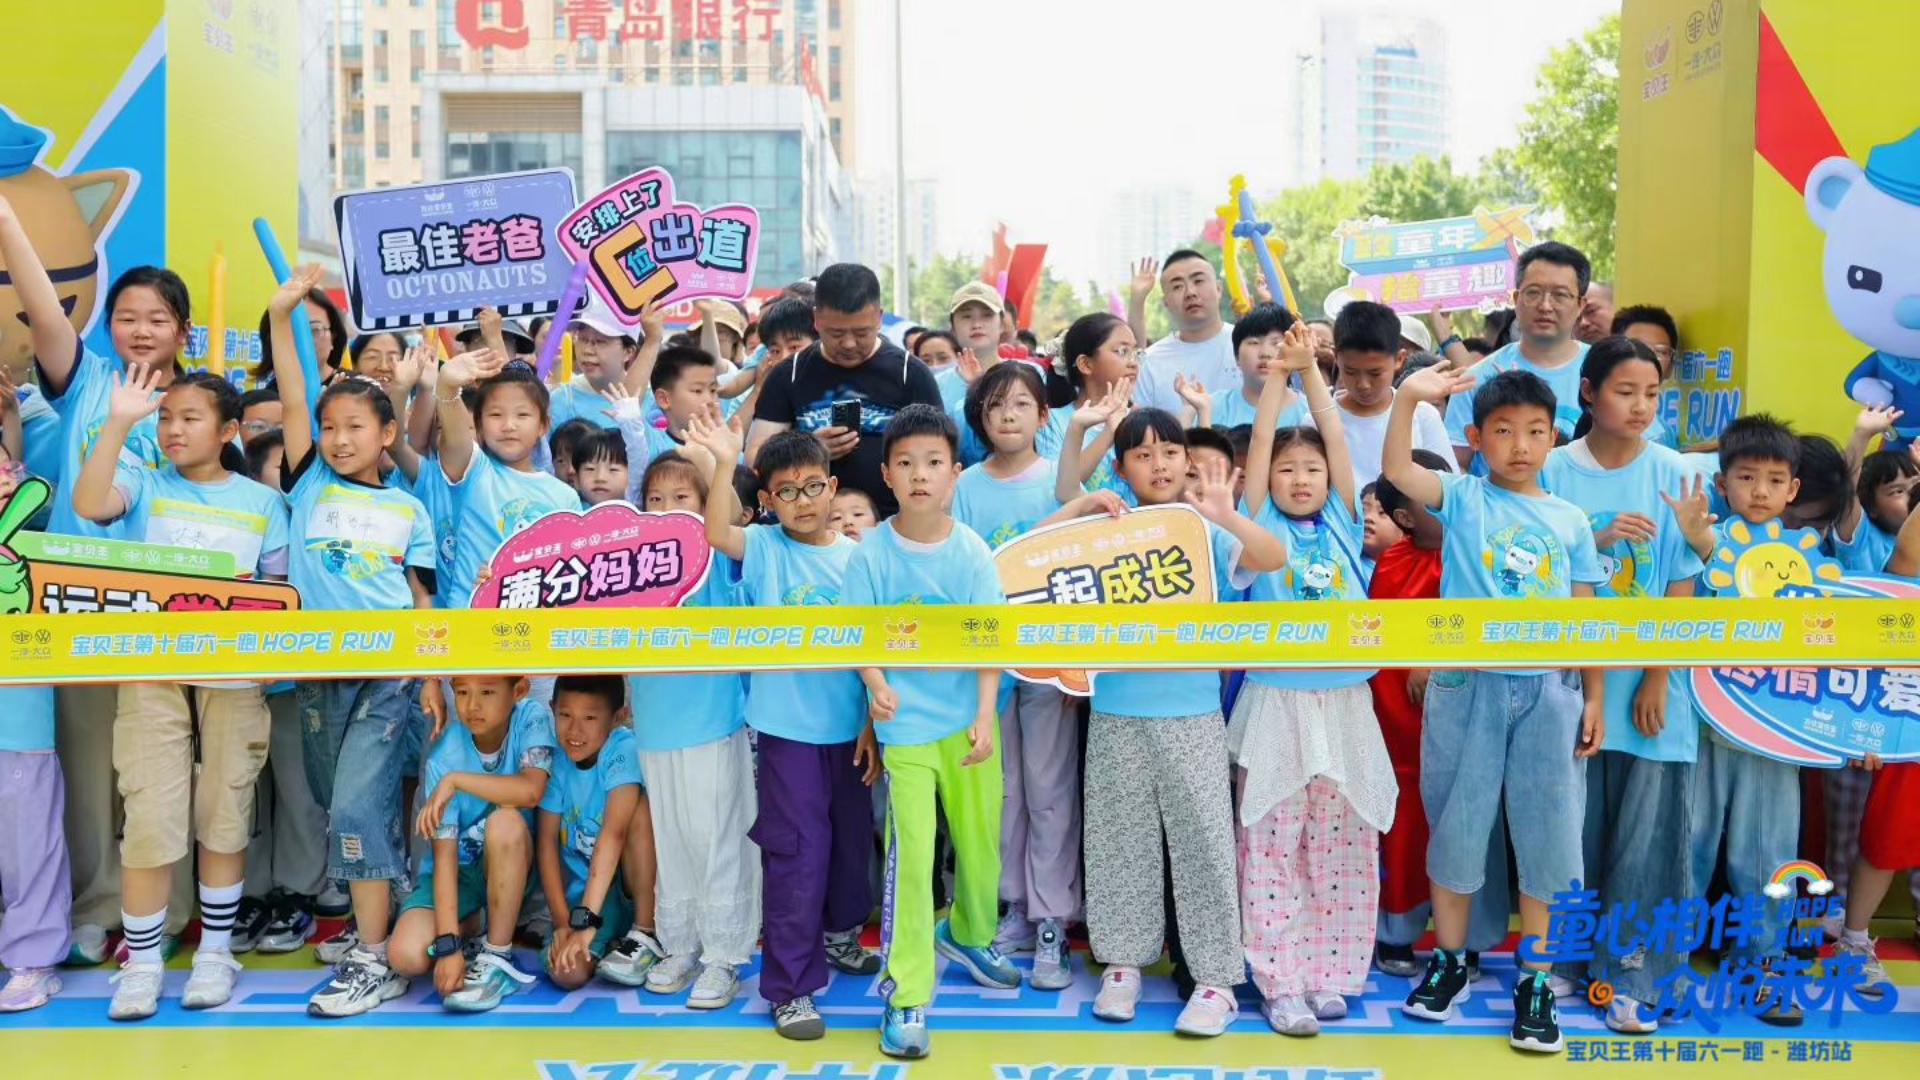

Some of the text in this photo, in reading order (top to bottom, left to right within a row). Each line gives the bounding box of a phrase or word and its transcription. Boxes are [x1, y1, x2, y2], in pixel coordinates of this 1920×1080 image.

[570, 179, 662, 248] 安排上了
[378, 214, 545, 276] 最佳老爸
[386, 263, 548, 300] OCTONAUTS
[498, 538, 682, 608] 满分妈妈
[1006, 547, 1192, 604] 一起成长
[70, 630, 395, 657] 宝贝王第十届六一跑 HOPE RUN
[549, 624, 864, 650] 宝贝王第十届六一跑 HOPE RUN
[1016, 620, 1328, 645] 宝贝王第十届六一跑 HOPE RUN
[1349, 635, 1383, 645] 宝贝王
[1481, 619, 1784, 642] 宝贝王第十届六一跑 HOPE RUN
[1803, 634, 1835, 644] 宝贝王
[416, 643, 449, 655] 宝贝王
[884, 639, 918, 649] 宝贝王
